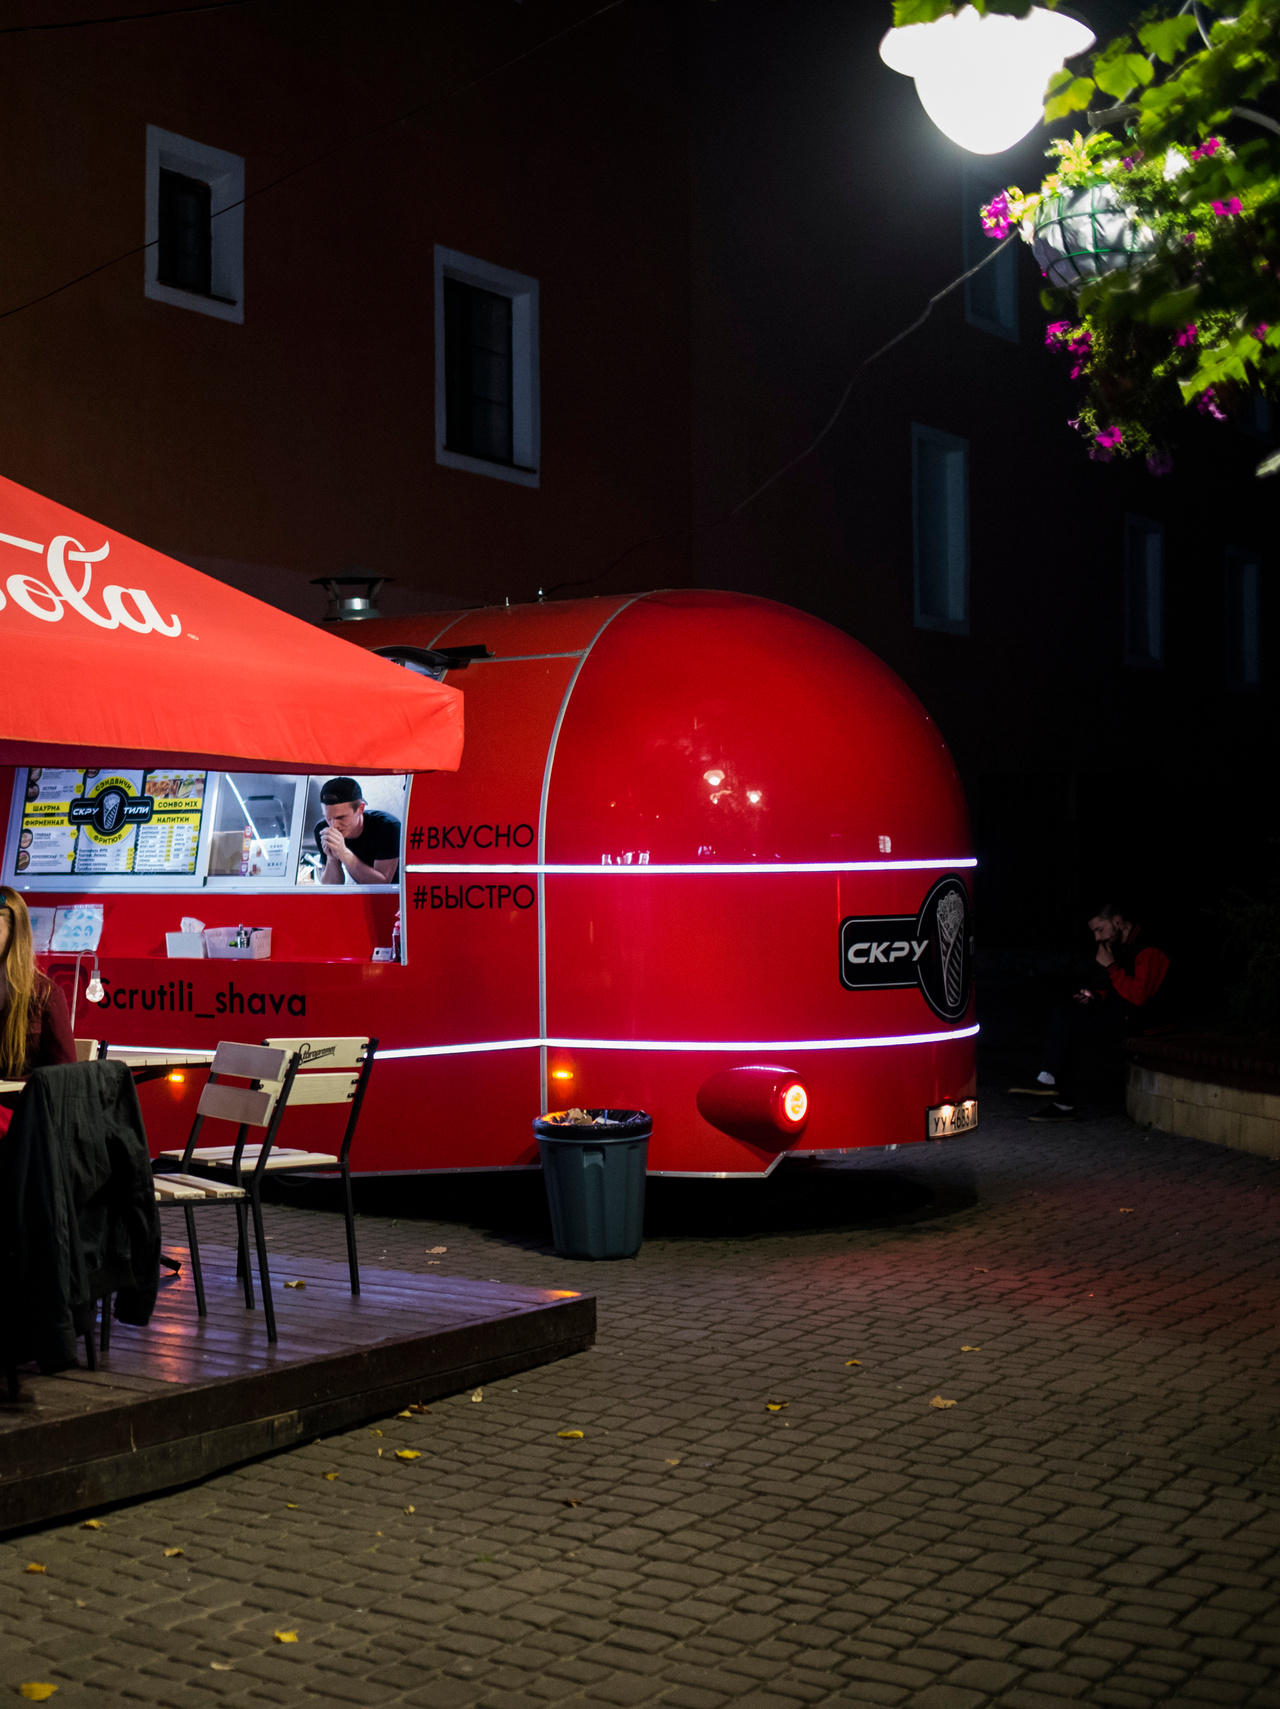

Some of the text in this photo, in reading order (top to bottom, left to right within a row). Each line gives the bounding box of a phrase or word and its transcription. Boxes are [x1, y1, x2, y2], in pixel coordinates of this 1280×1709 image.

[95, 778, 132, 792] СЭНДВИЧИ
[94, 833, 122, 844] ФРИТЮР
[410, 824, 534, 849] #ВКУСНО
[412, 884, 535, 909] #БЫСТРО
[847, 940, 929, 964] СКРУ
